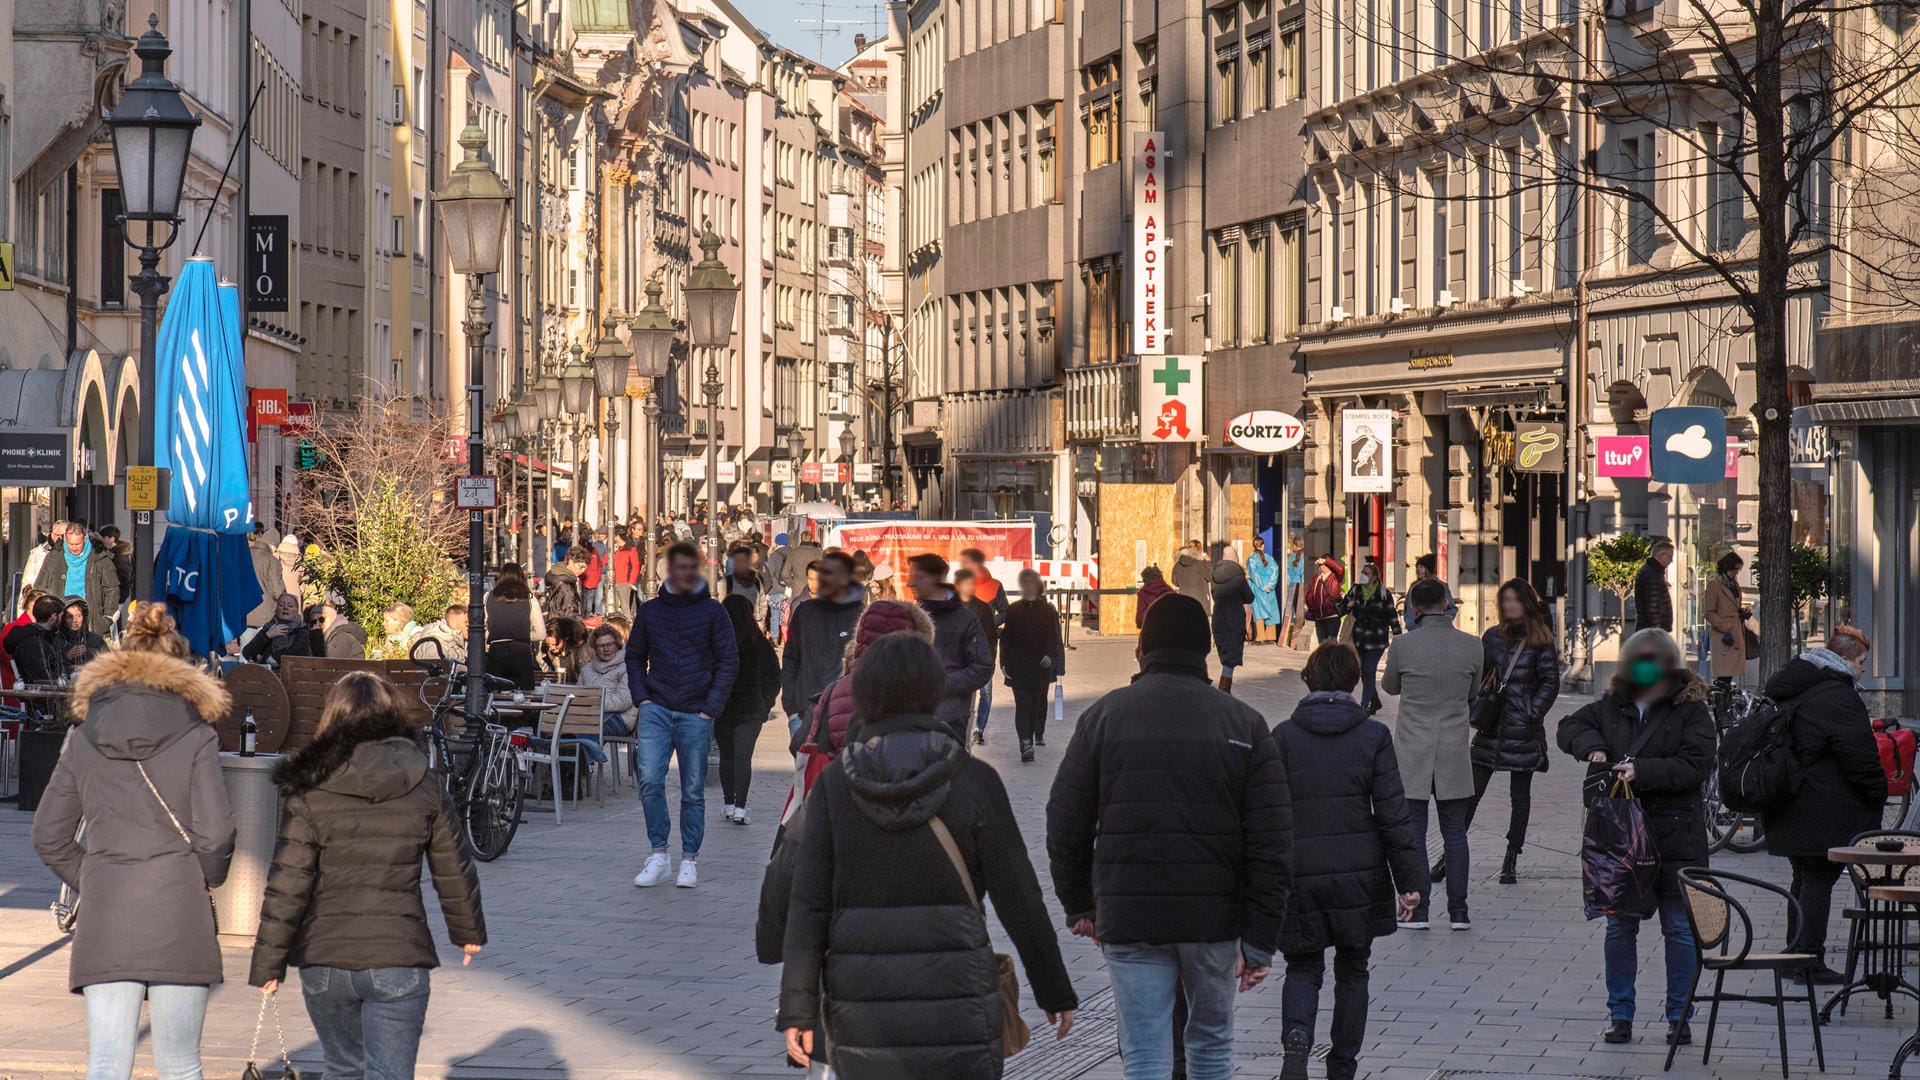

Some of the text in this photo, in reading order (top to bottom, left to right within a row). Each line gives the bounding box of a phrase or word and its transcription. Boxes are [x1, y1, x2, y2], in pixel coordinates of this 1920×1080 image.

[1144, 138, 1157, 349] ASAM APOTHEKE
[256, 233, 273, 295] MIO
[257, 399, 282, 414] JBL
[1285, 425, 1300, 439] 17
[1, 448, 62, 457] PHONE KLINIK
[460, 479, 488, 487] H 300
